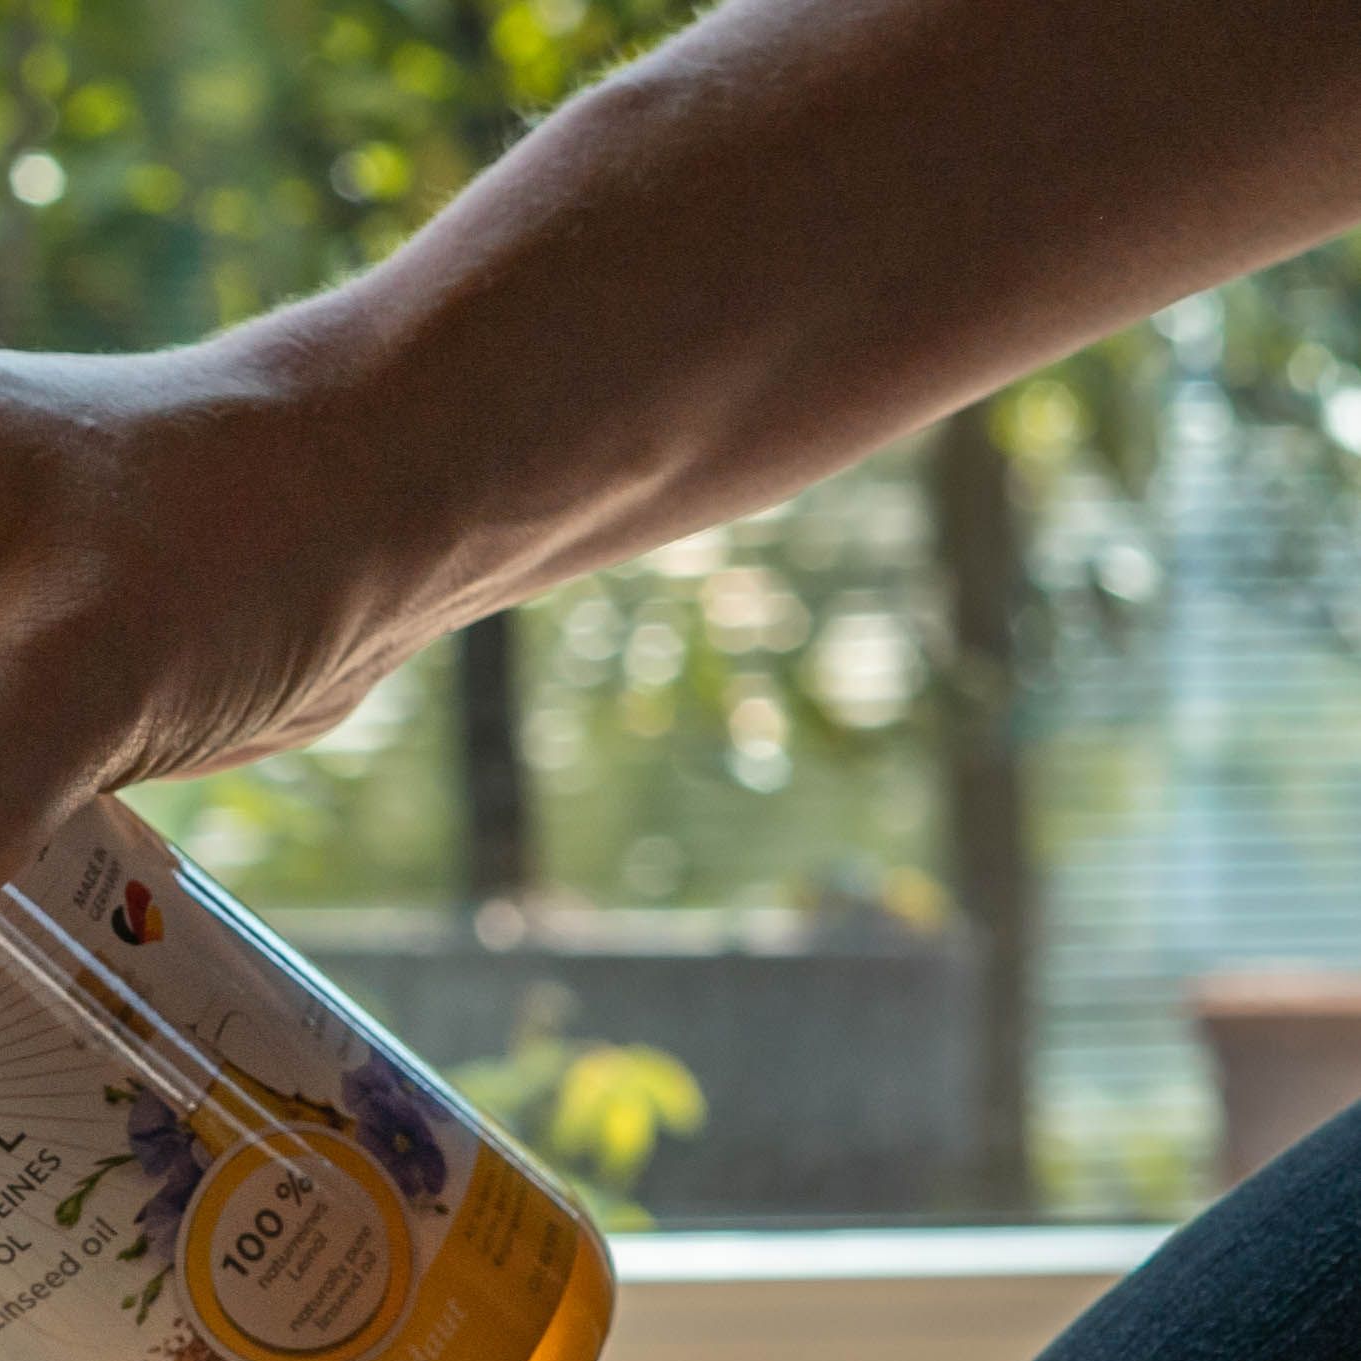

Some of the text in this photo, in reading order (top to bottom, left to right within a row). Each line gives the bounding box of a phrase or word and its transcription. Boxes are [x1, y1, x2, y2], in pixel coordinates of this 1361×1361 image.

[81, 1216, 118, 1256] oil
[222, 1171, 314, 1277] 100 %
[290, 1225, 372, 1332] naturally pure
[313, 1272, 363, 1331] linseed
